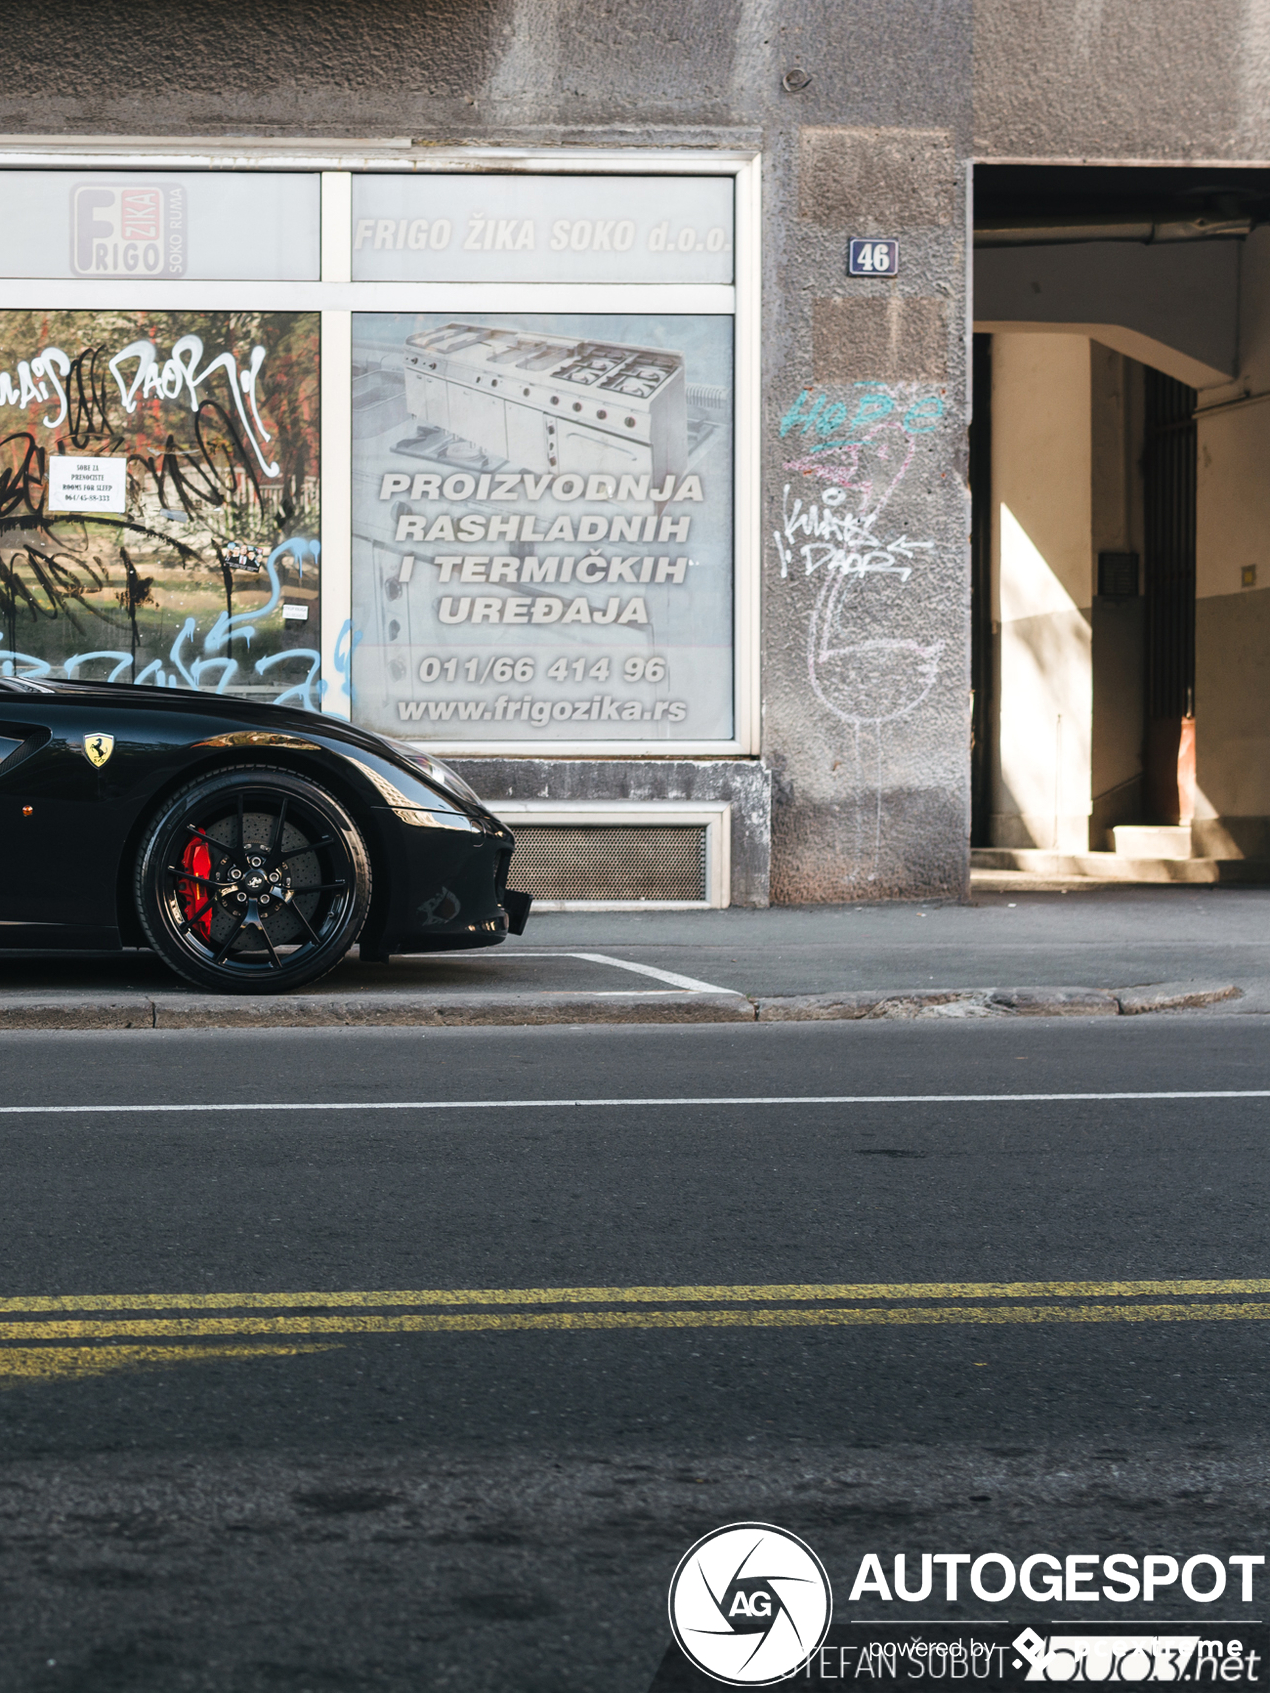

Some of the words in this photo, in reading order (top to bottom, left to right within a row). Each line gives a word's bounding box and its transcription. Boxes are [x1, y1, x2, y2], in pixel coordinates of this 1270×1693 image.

[124, 193, 157, 237] ZIKA
[169, 188, 183, 229] RUMA
[77, 189, 160, 272] FRIGO
[354, 219, 452, 251] FRIGO
[463, 213, 536, 251] ŽIKA
[550, 220, 635, 252] SOKO
[648, 222, 731, 252] d.o.o.
[169, 234, 183, 273] SOKO
[857, 243, 890, 271] 46
[379, 473, 705, 501] PROIZVODNJA
[394, 515, 692, 542] RASHLADNIH
[398, 556, 415, 582] I
[433, 549, 689, 583] TERMIČKIH
[438, 597, 649, 624] UREĐAJA
[418, 657, 535, 684] 011/66
[548, 657, 610, 682] 414
[623, 657, 666, 682] 96
[398, 695, 688, 728] www.frigozika.rs
